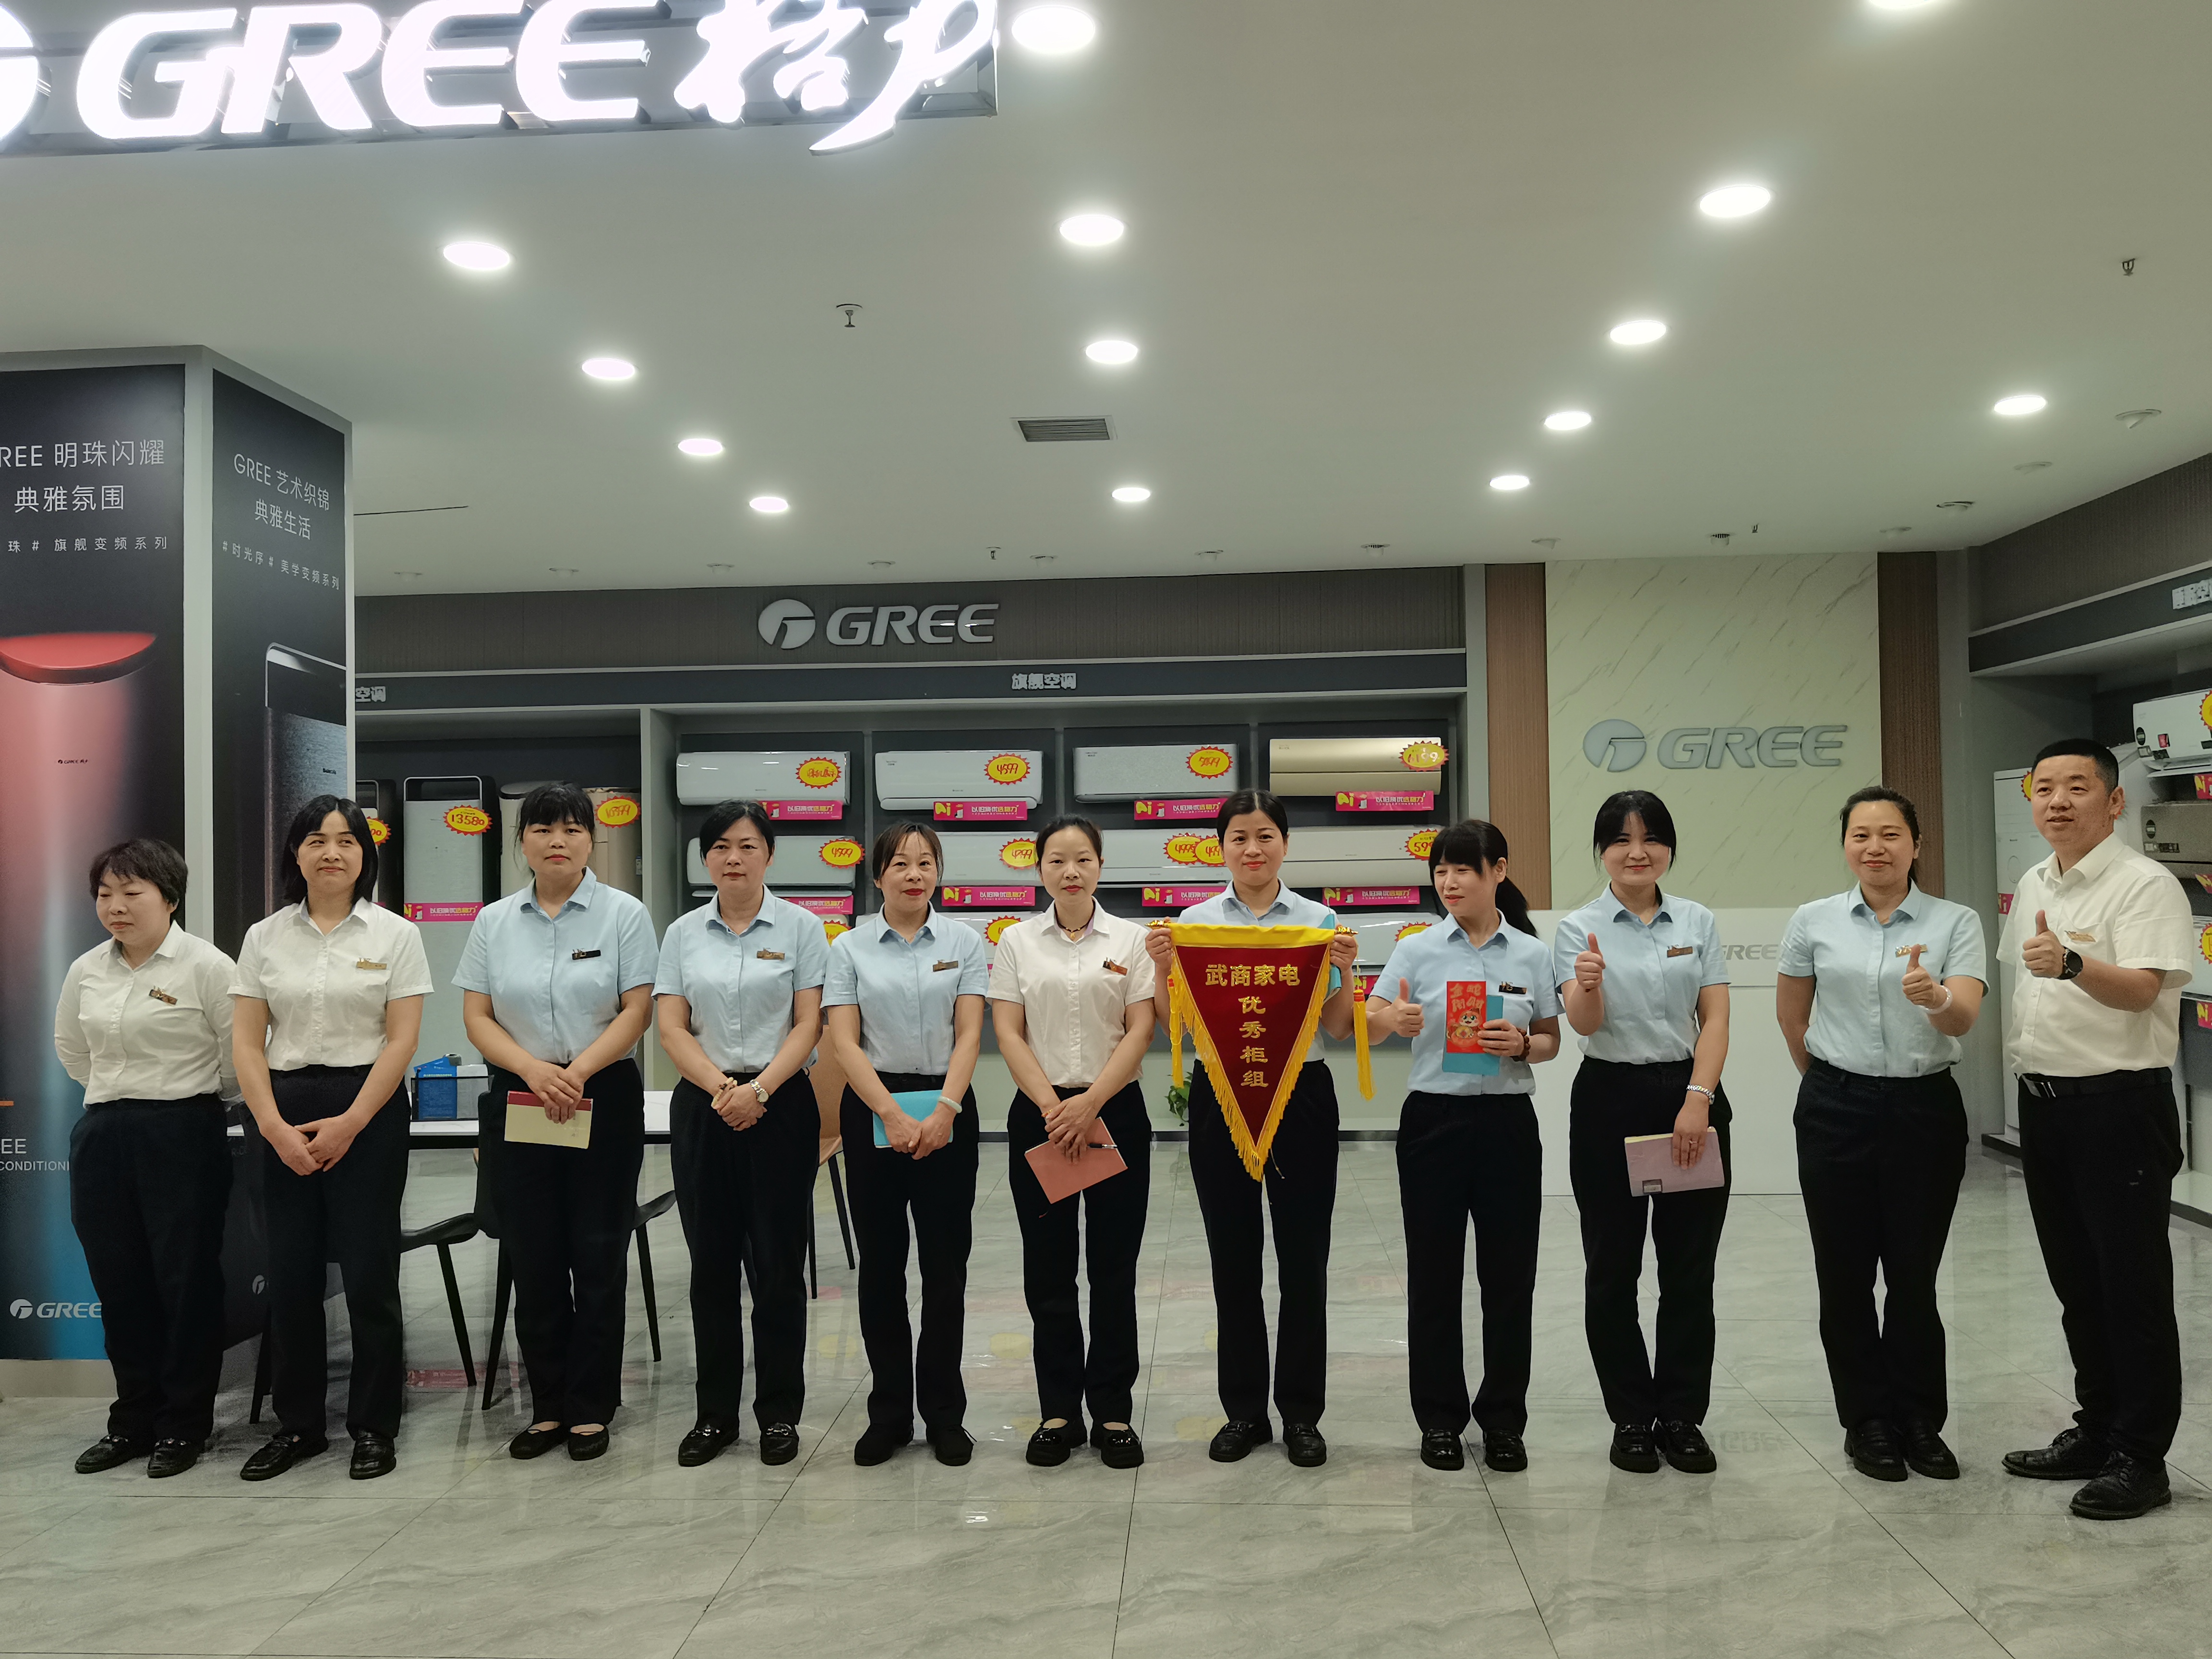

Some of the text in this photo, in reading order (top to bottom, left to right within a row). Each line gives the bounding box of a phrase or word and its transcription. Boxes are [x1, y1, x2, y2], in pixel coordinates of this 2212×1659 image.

[77, 0, 658, 138] GREE
[0, 439, 165, 468] REE 明珠闪耀
[234, 454, 329, 511] GREE 艺术织锦
[14, 485, 124, 513] 典雅氛围
[254, 498, 311, 540] 典雅生活
[54, 536, 167, 552] 旗舰变频系列
[281, 559, 339, 590] 美学变频系列
[826, 603, 999, 646] GREE
[356, 686, 386, 702] 空调
[1011, 673, 1077, 690] 旗舰空调
[1657, 725, 1848, 769] GREE
[997, 763, 1019, 775] 4599
[1205, 963, 1300, 986] 武商家电
[1238, 996, 1269, 1087] 优秀柜组
[36, 1302, 102, 1318] GREE
